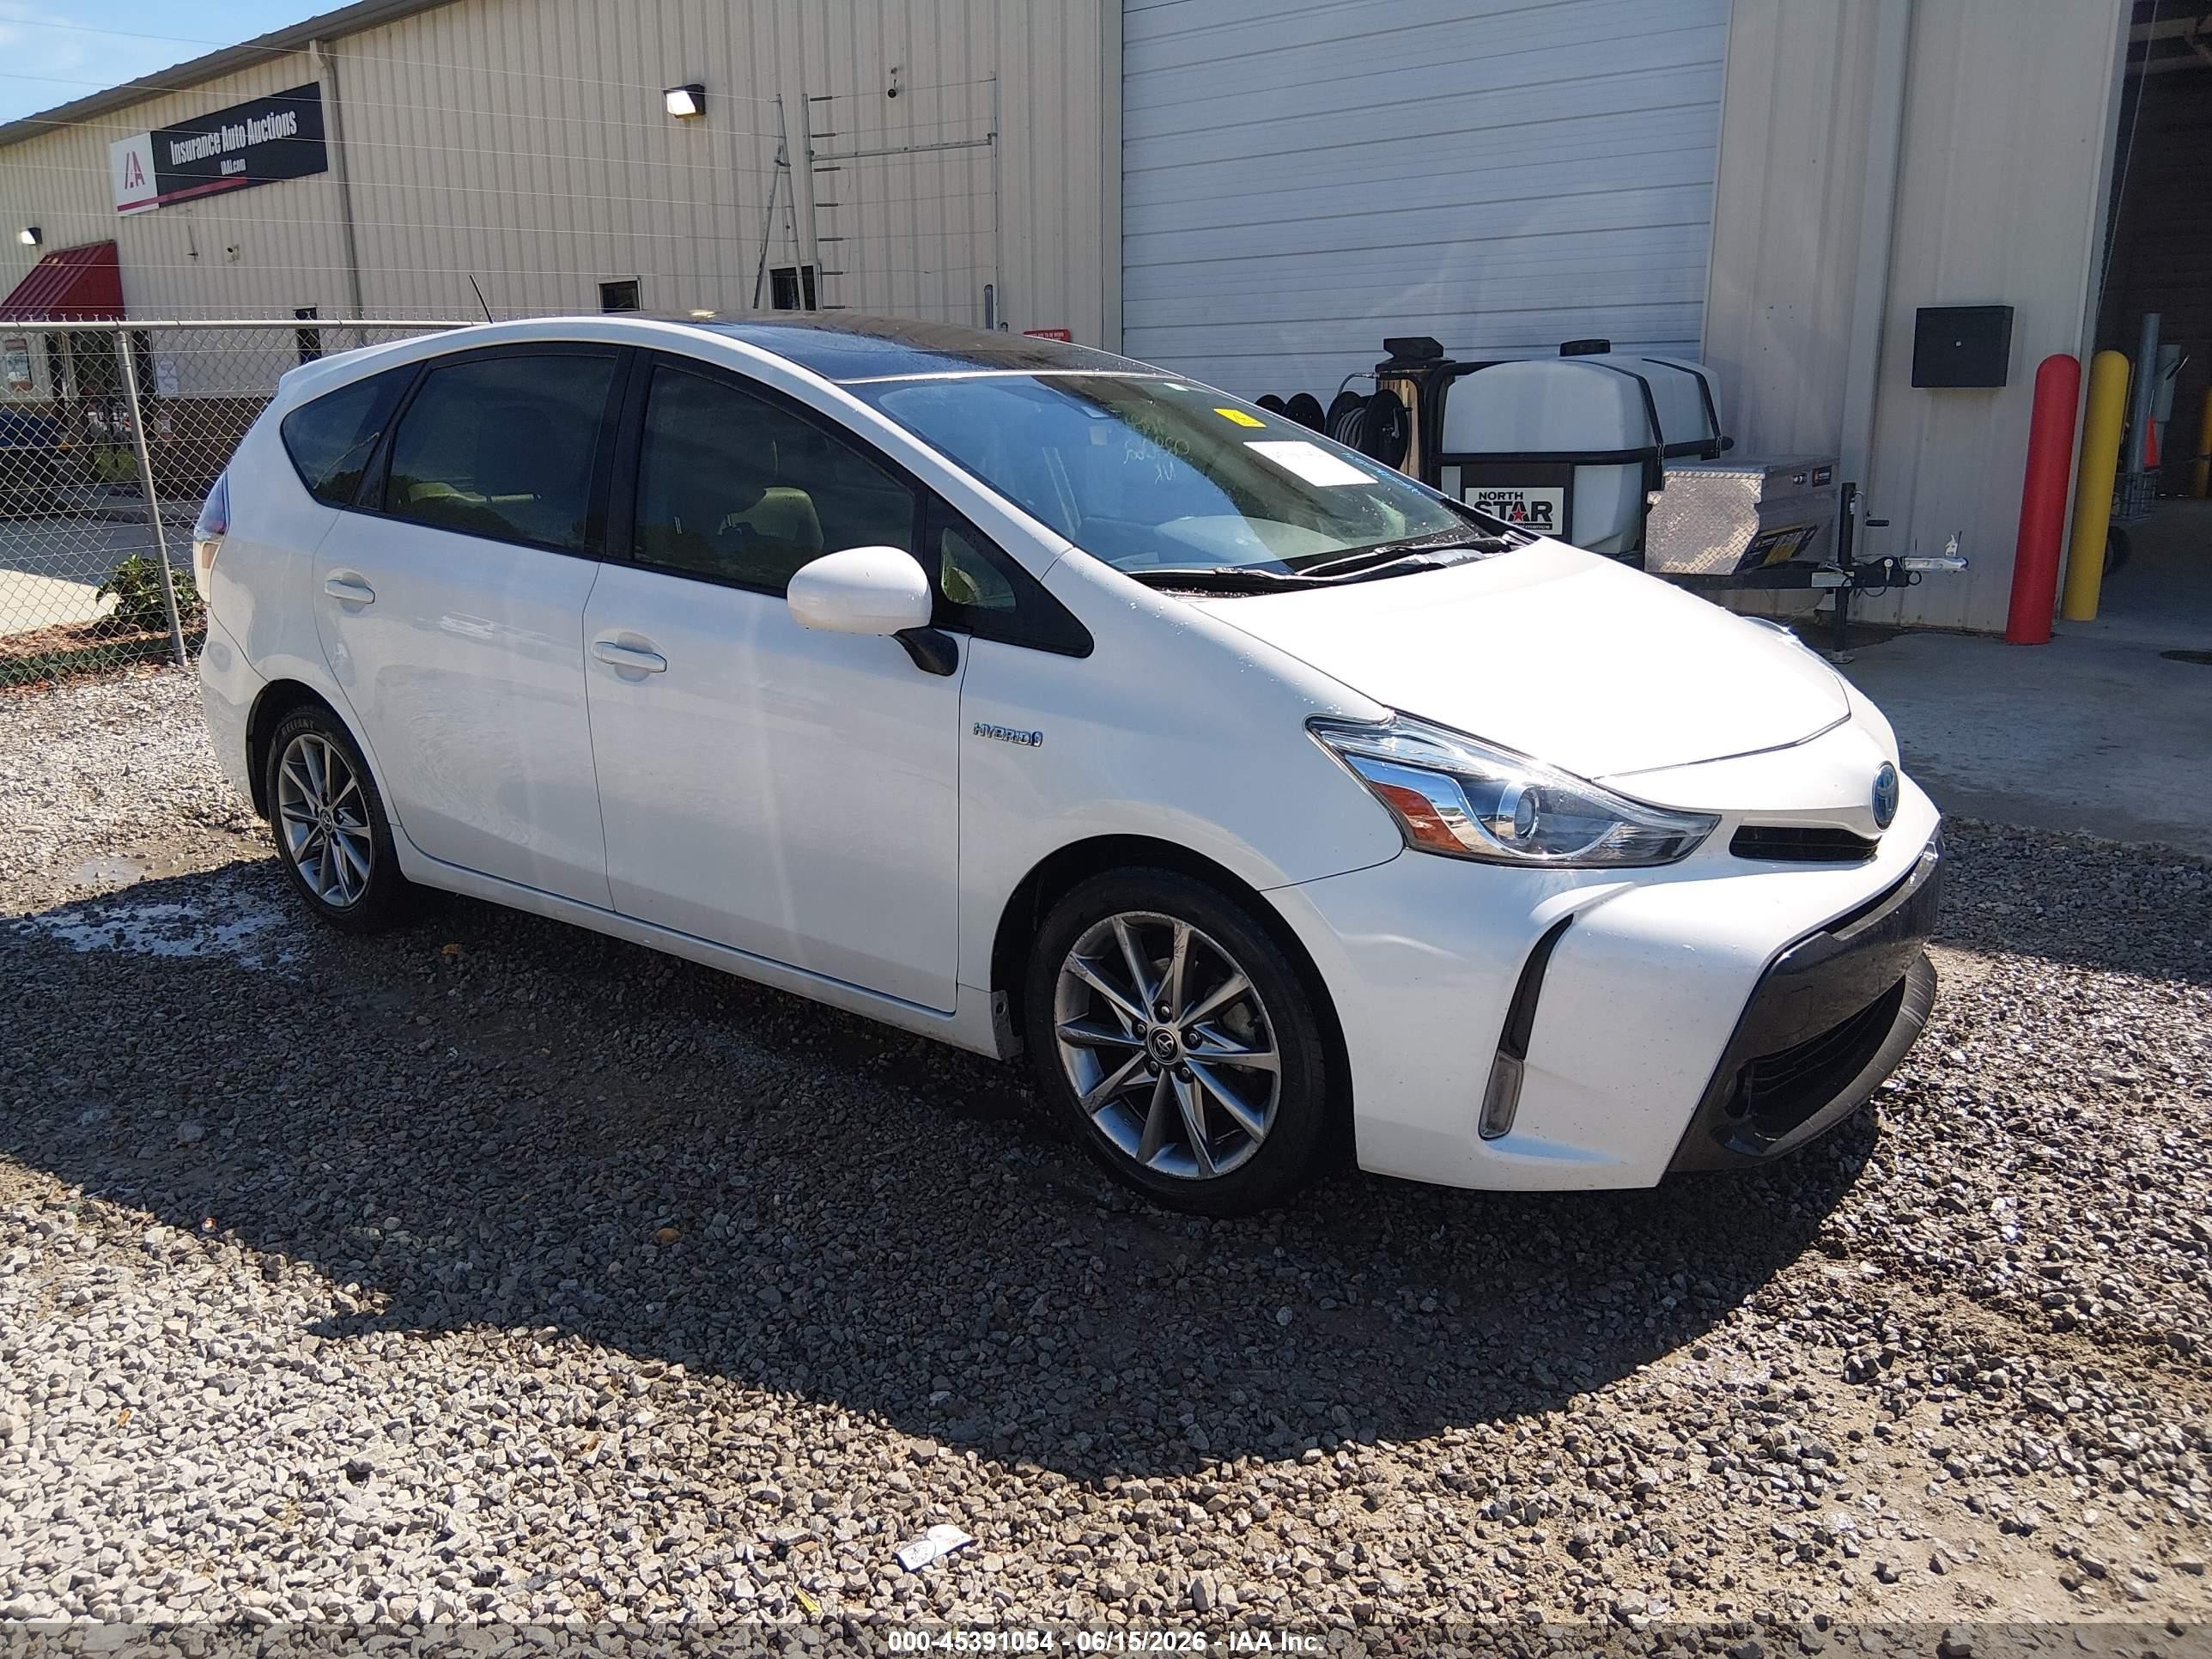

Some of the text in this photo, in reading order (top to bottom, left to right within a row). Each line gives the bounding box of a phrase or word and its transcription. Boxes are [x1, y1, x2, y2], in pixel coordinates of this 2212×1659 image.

[170, 110, 297, 165] Insurance Auto Auctions
[1479, 491, 1523, 501] NORTH
[1474, 501, 1553, 522] STAR
[973, 722, 1032, 745] HYBRID
